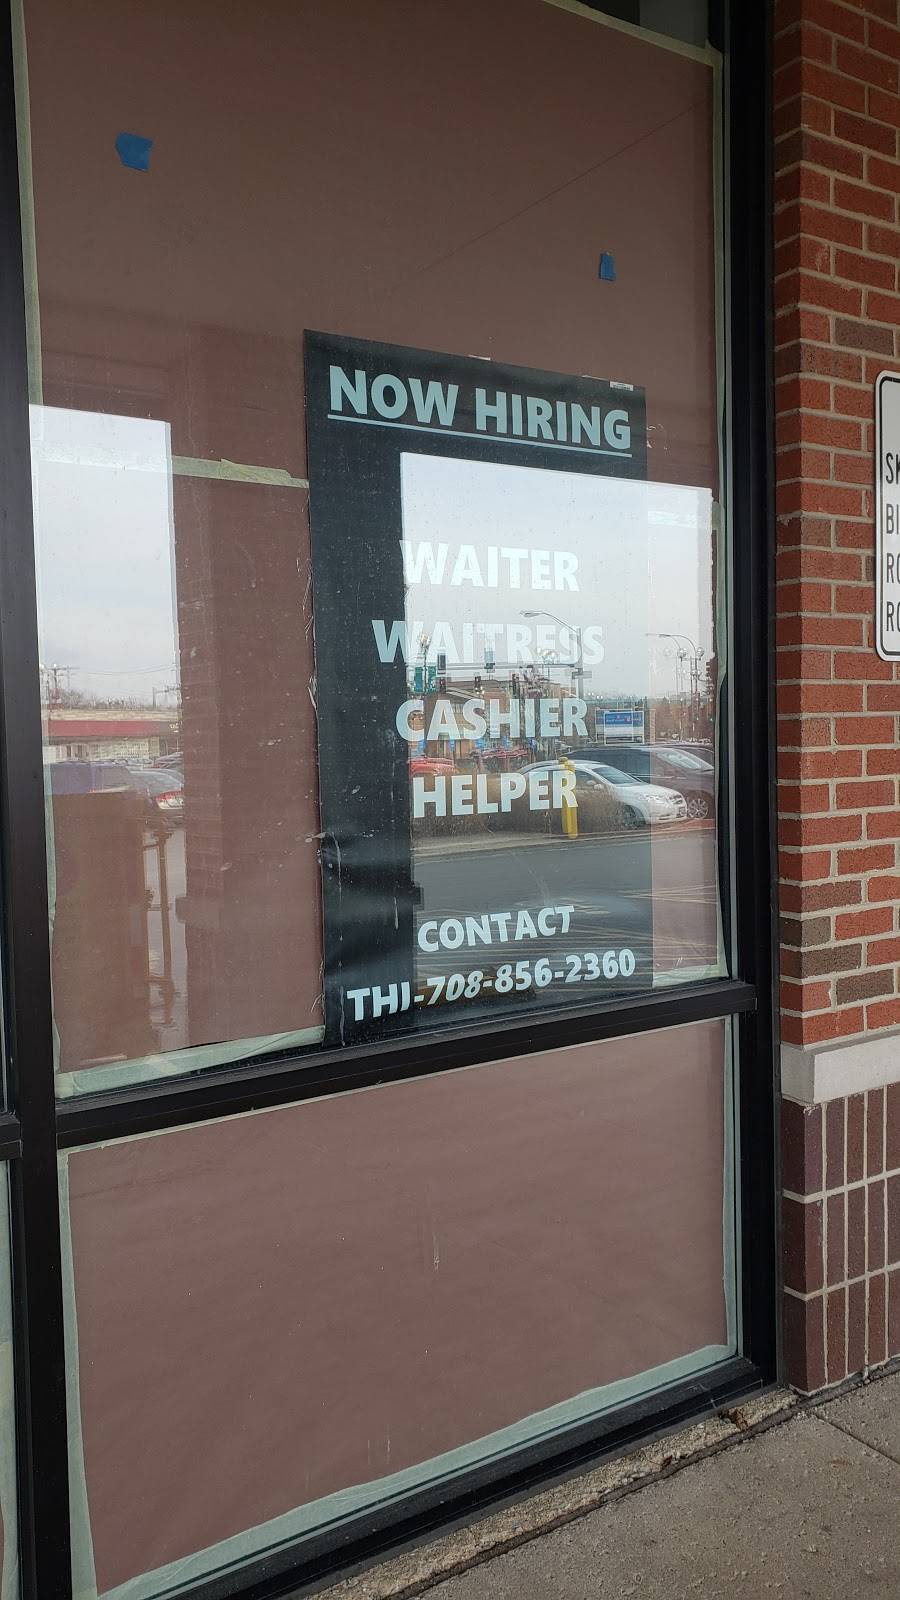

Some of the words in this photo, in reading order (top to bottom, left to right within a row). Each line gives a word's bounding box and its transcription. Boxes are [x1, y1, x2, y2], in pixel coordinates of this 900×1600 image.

[329, 364, 459, 427] NOW
[475, 387, 631, 449] HIRING
[400, 540, 580, 592] WAITER
[371, 619, 605, 665] WAITRESS
[396, 698, 588, 742] CASHIER
[412, 770, 578, 818] HELPER
[417, 905, 575, 953] CONTACT
